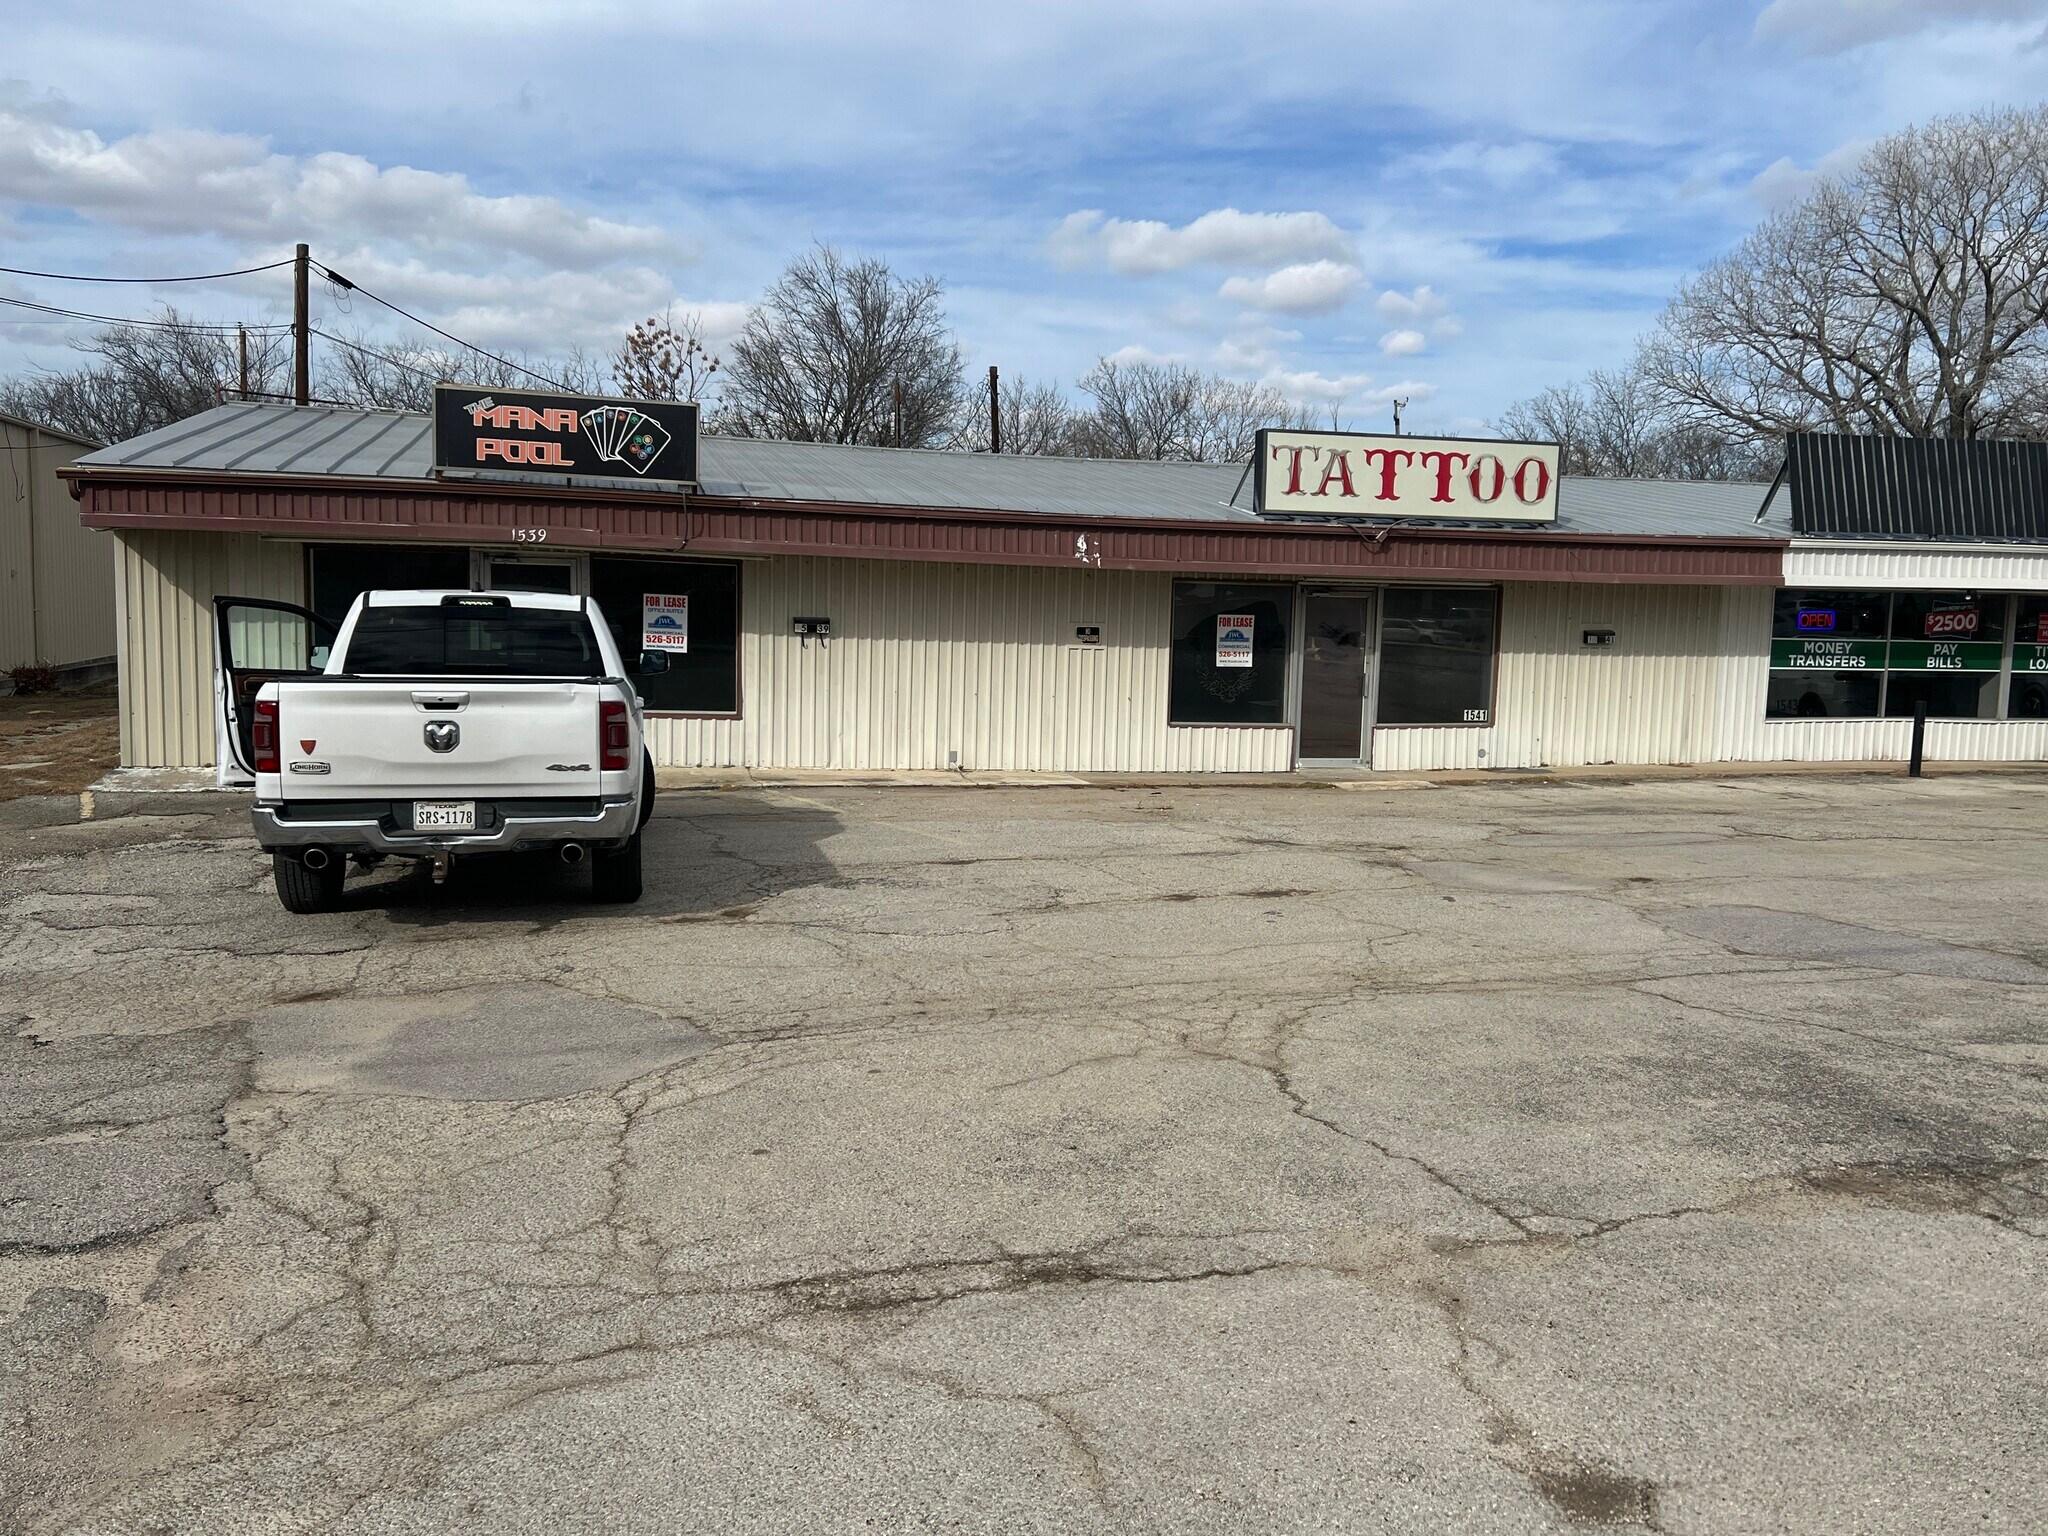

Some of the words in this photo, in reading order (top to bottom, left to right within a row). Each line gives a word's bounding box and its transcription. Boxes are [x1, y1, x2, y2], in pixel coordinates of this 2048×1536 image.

[463, 397, 495, 415] THE
[473, 405, 577, 433] MANA
[476, 437, 575, 466] POOL
[1269, 444, 1552, 505] TATTOO
[511, 528, 547, 542] 1539
[645, 596, 660, 607] FOR
[664, 597, 686, 608] LEASE
[1219, 617, 1231, 627] FOR
[1233, 617, 1252, 627] LEASE
[1800, 613, 1833, 627] OPEN
[1927, 613, 1977, 632] $2500
[646, 634, 685, 644] 526-5117
[1804, 641, 1853, 654] MONEY
[1933, 643, 1959, 656] PAY
[2035, 645, 2048, 657] TI
[1788, 654, 1866, 668] TRANSFERS
[1926, 656, 1962, 668] BILLS
[2029, 658, 2048, 670] LO
[1465, 710, 1486, 721] 1541
